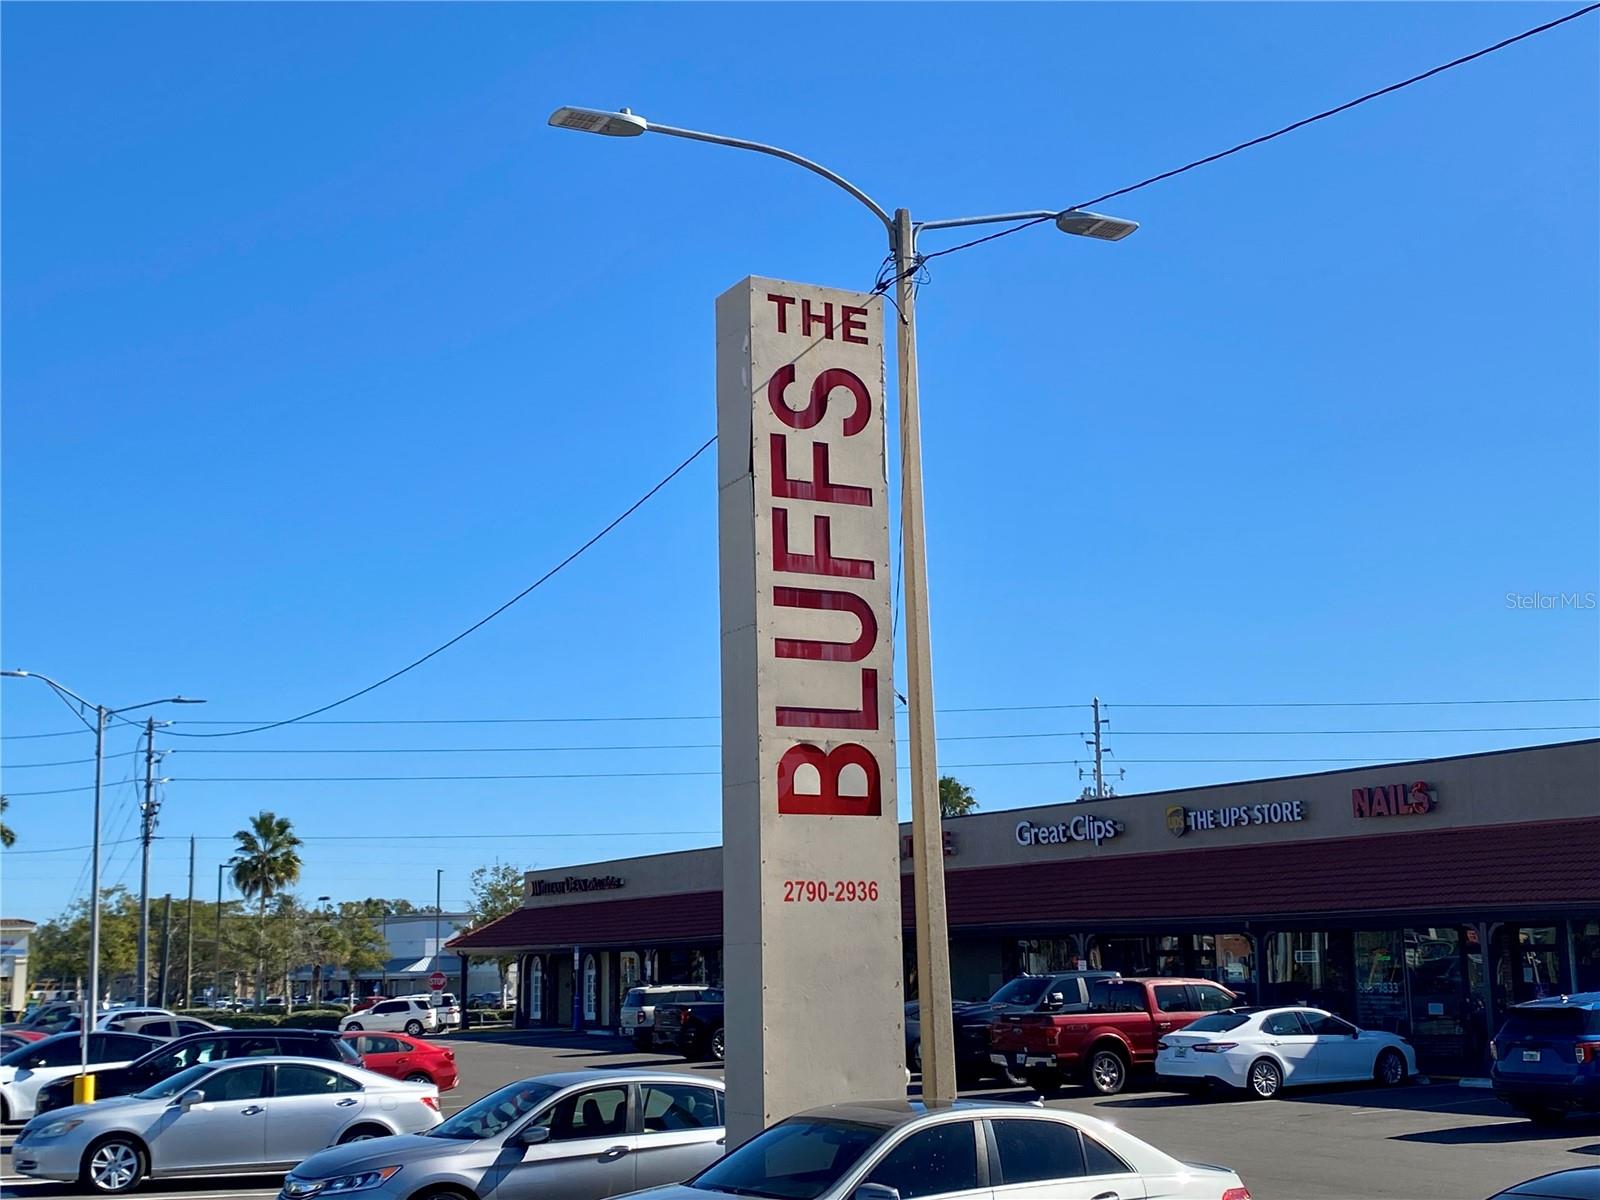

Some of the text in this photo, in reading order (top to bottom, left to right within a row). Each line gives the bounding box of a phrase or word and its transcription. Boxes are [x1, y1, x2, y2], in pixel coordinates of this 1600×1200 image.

[767, 293, 869, 345] THE
[767, 363, 882, 817] BLUFFS
[1187, 801, 1303, 831] THE UPS STORE
[1352, 780, 1431, 818] NAILS
[1015, 815, 1116, 846] Great Clips
[783, 879, 879, 902] 2790-2936
